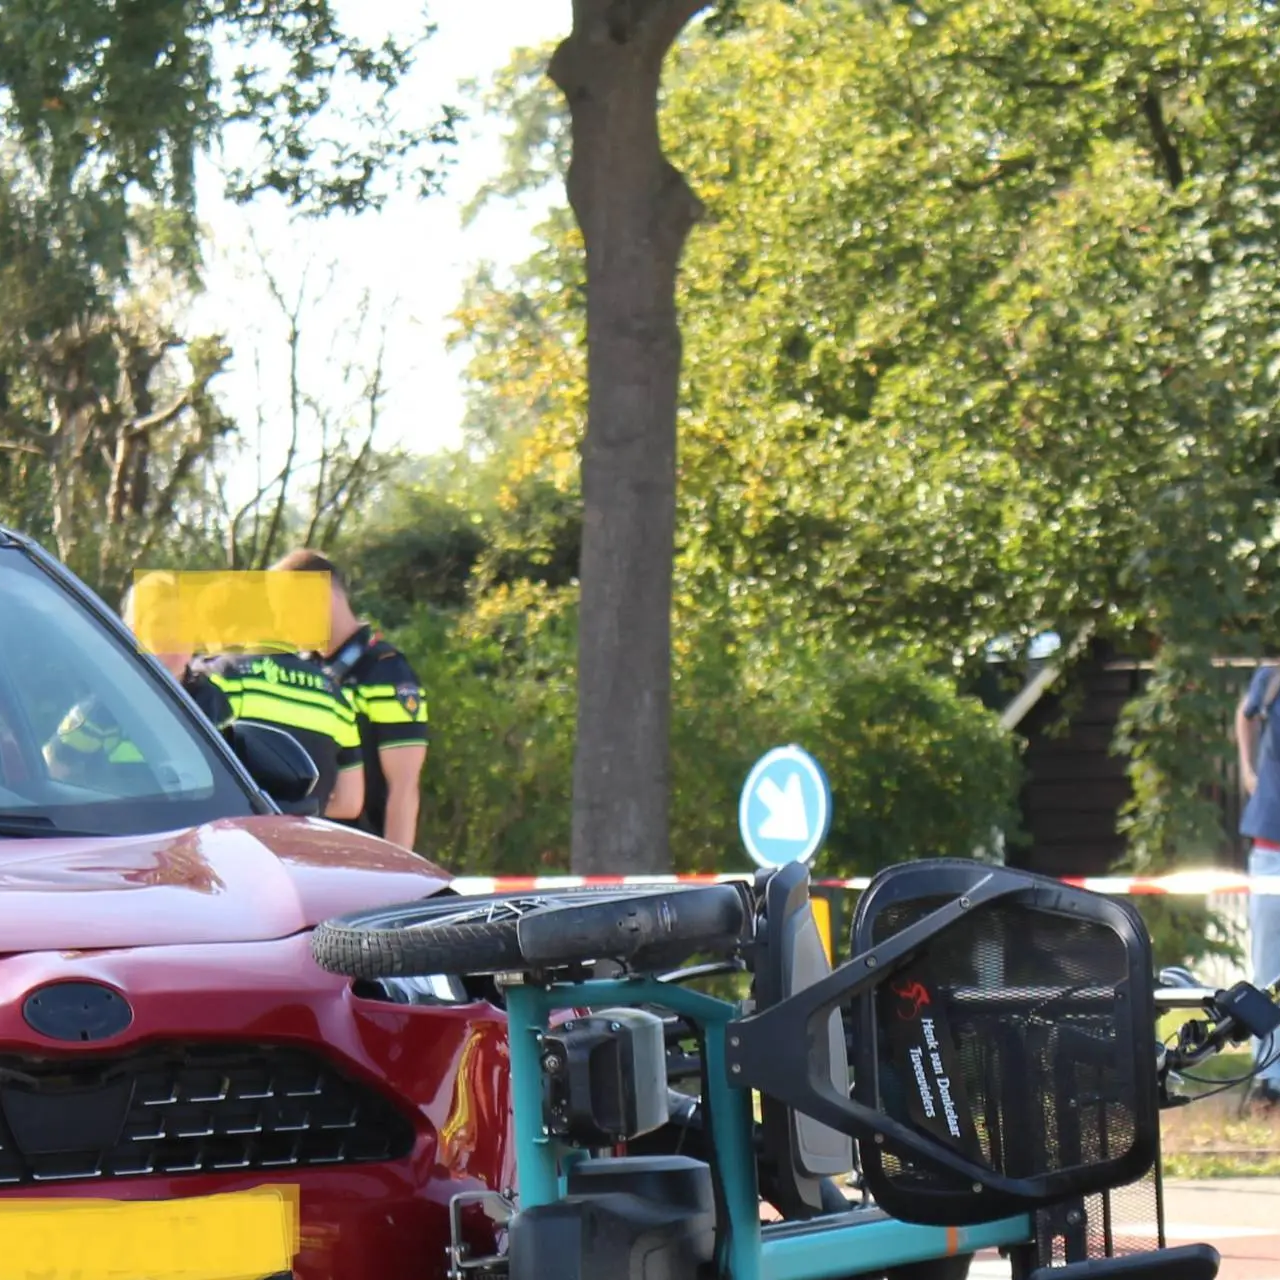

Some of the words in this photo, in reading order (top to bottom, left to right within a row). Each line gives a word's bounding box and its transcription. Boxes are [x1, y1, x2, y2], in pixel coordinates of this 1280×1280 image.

[921, 1018, 939, 1050] Henk
[909, 1046, 936, 1118] Tweewielers
[930, 1052, 944, 1075] van
[936, 1077, 961, 1138] Donkelaar
